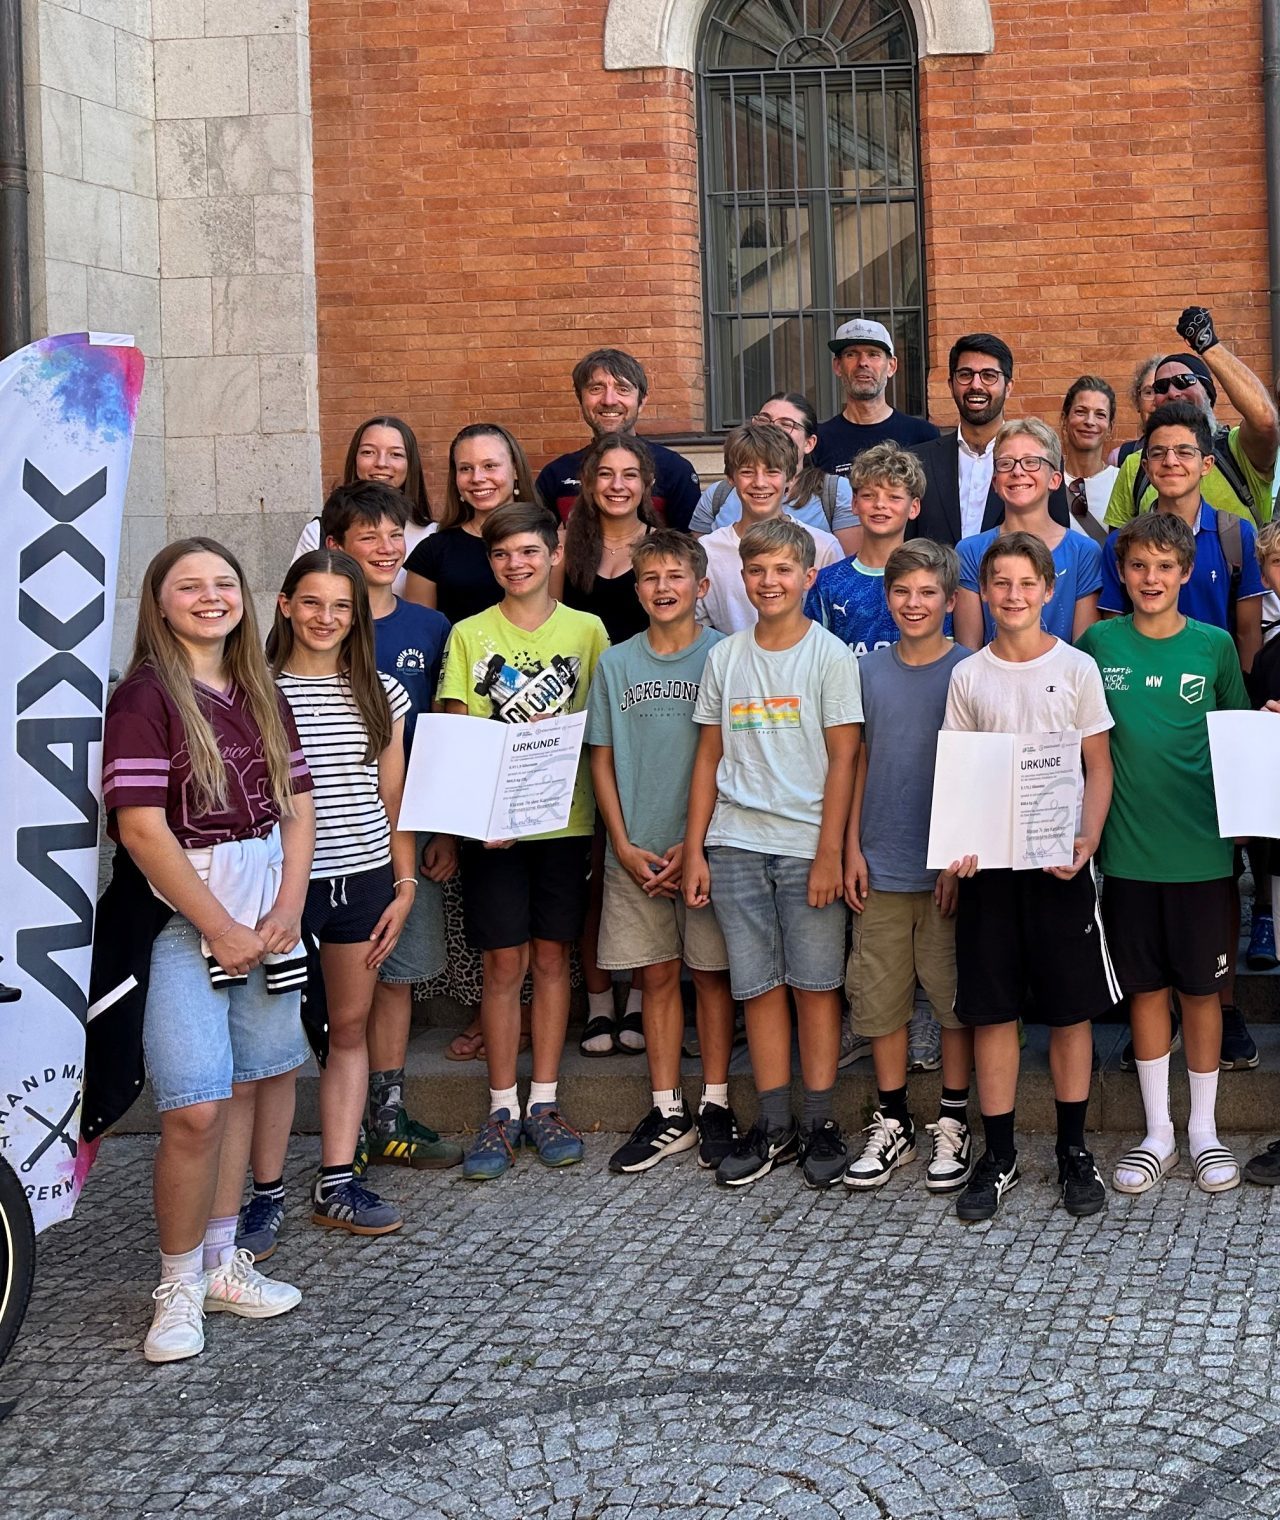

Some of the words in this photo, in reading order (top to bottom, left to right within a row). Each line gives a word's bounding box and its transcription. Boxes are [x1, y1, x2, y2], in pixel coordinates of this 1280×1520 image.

[1145, 675, 1163, 688] MW
[16, 458, 108, 1024] MAXX
[512, 737, 561, 752] URKUNDE
[1020, 756, 1062, 770] URKUNDE
